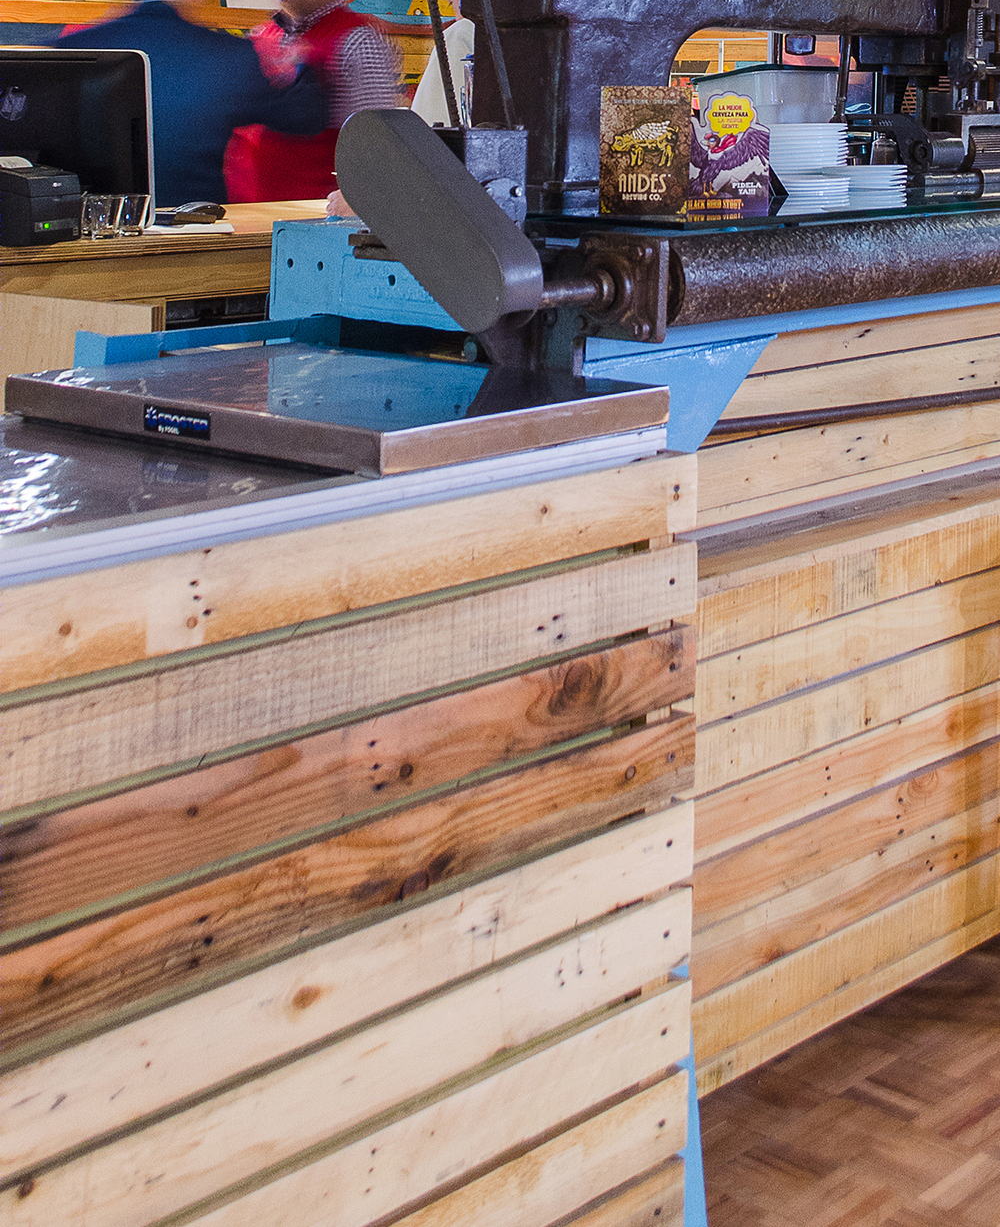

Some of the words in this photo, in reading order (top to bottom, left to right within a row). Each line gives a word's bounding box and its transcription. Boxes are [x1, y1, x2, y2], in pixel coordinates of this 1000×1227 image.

[619, 173, 667, 193] ANDES
[732, 181, 762, 189] PIDELA
[649, 193, 662, 201] CO.
